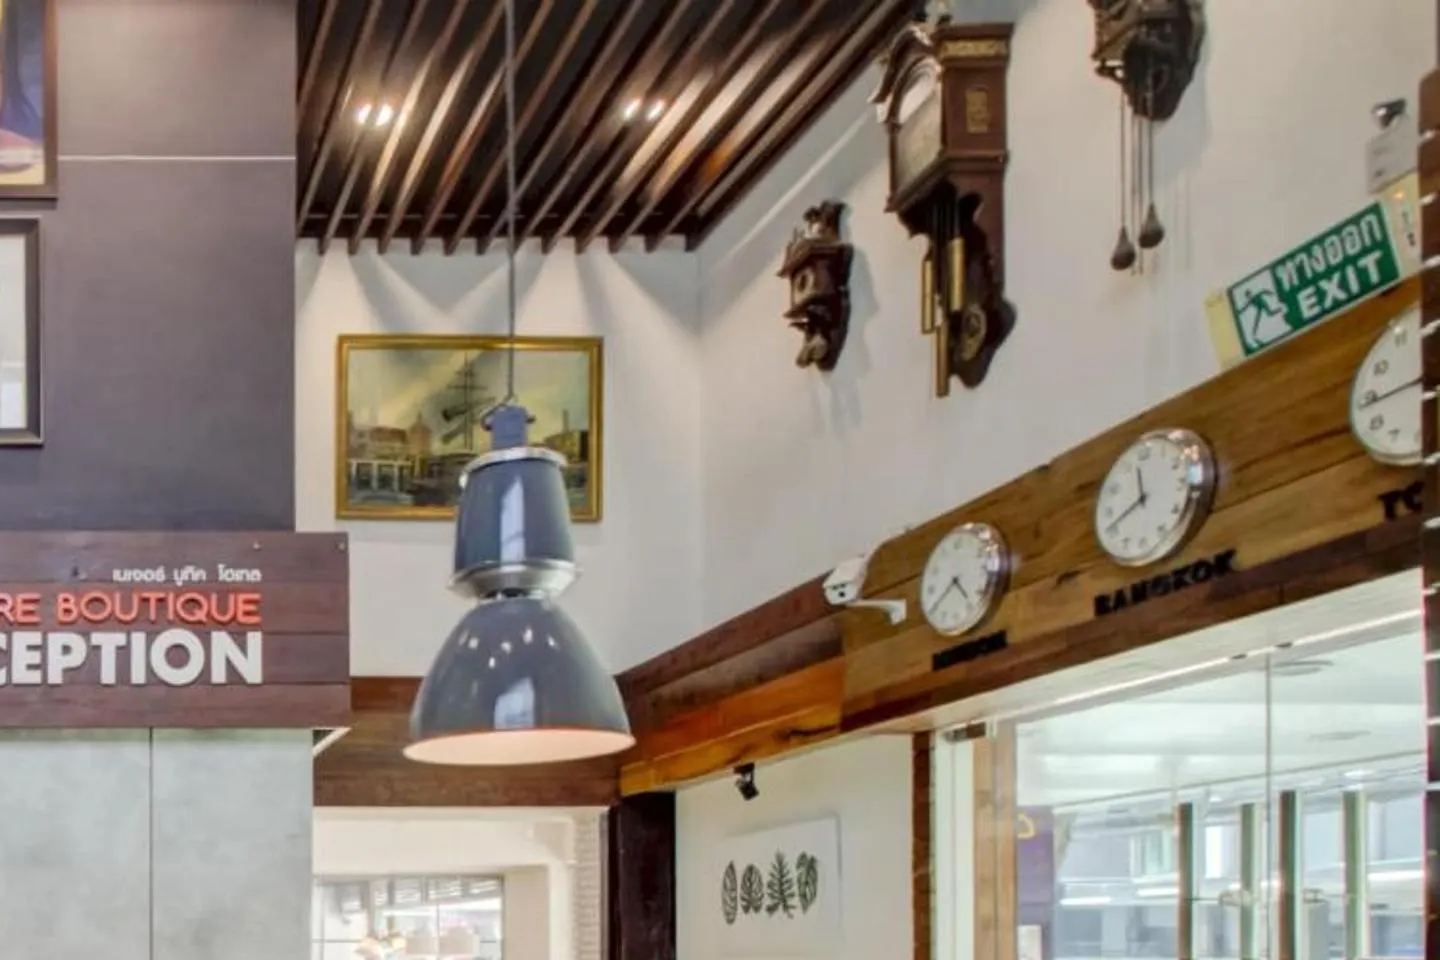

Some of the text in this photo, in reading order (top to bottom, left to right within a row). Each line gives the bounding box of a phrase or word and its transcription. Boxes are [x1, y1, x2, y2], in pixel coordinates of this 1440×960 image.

[1274, 212, 1384, 291] ทางออก
[1296, 250, 1383, 320] EXIT
[56, 591, 263, 625] BOUTIQUE
[1094, 548, 1237, 616] BANGKOK
